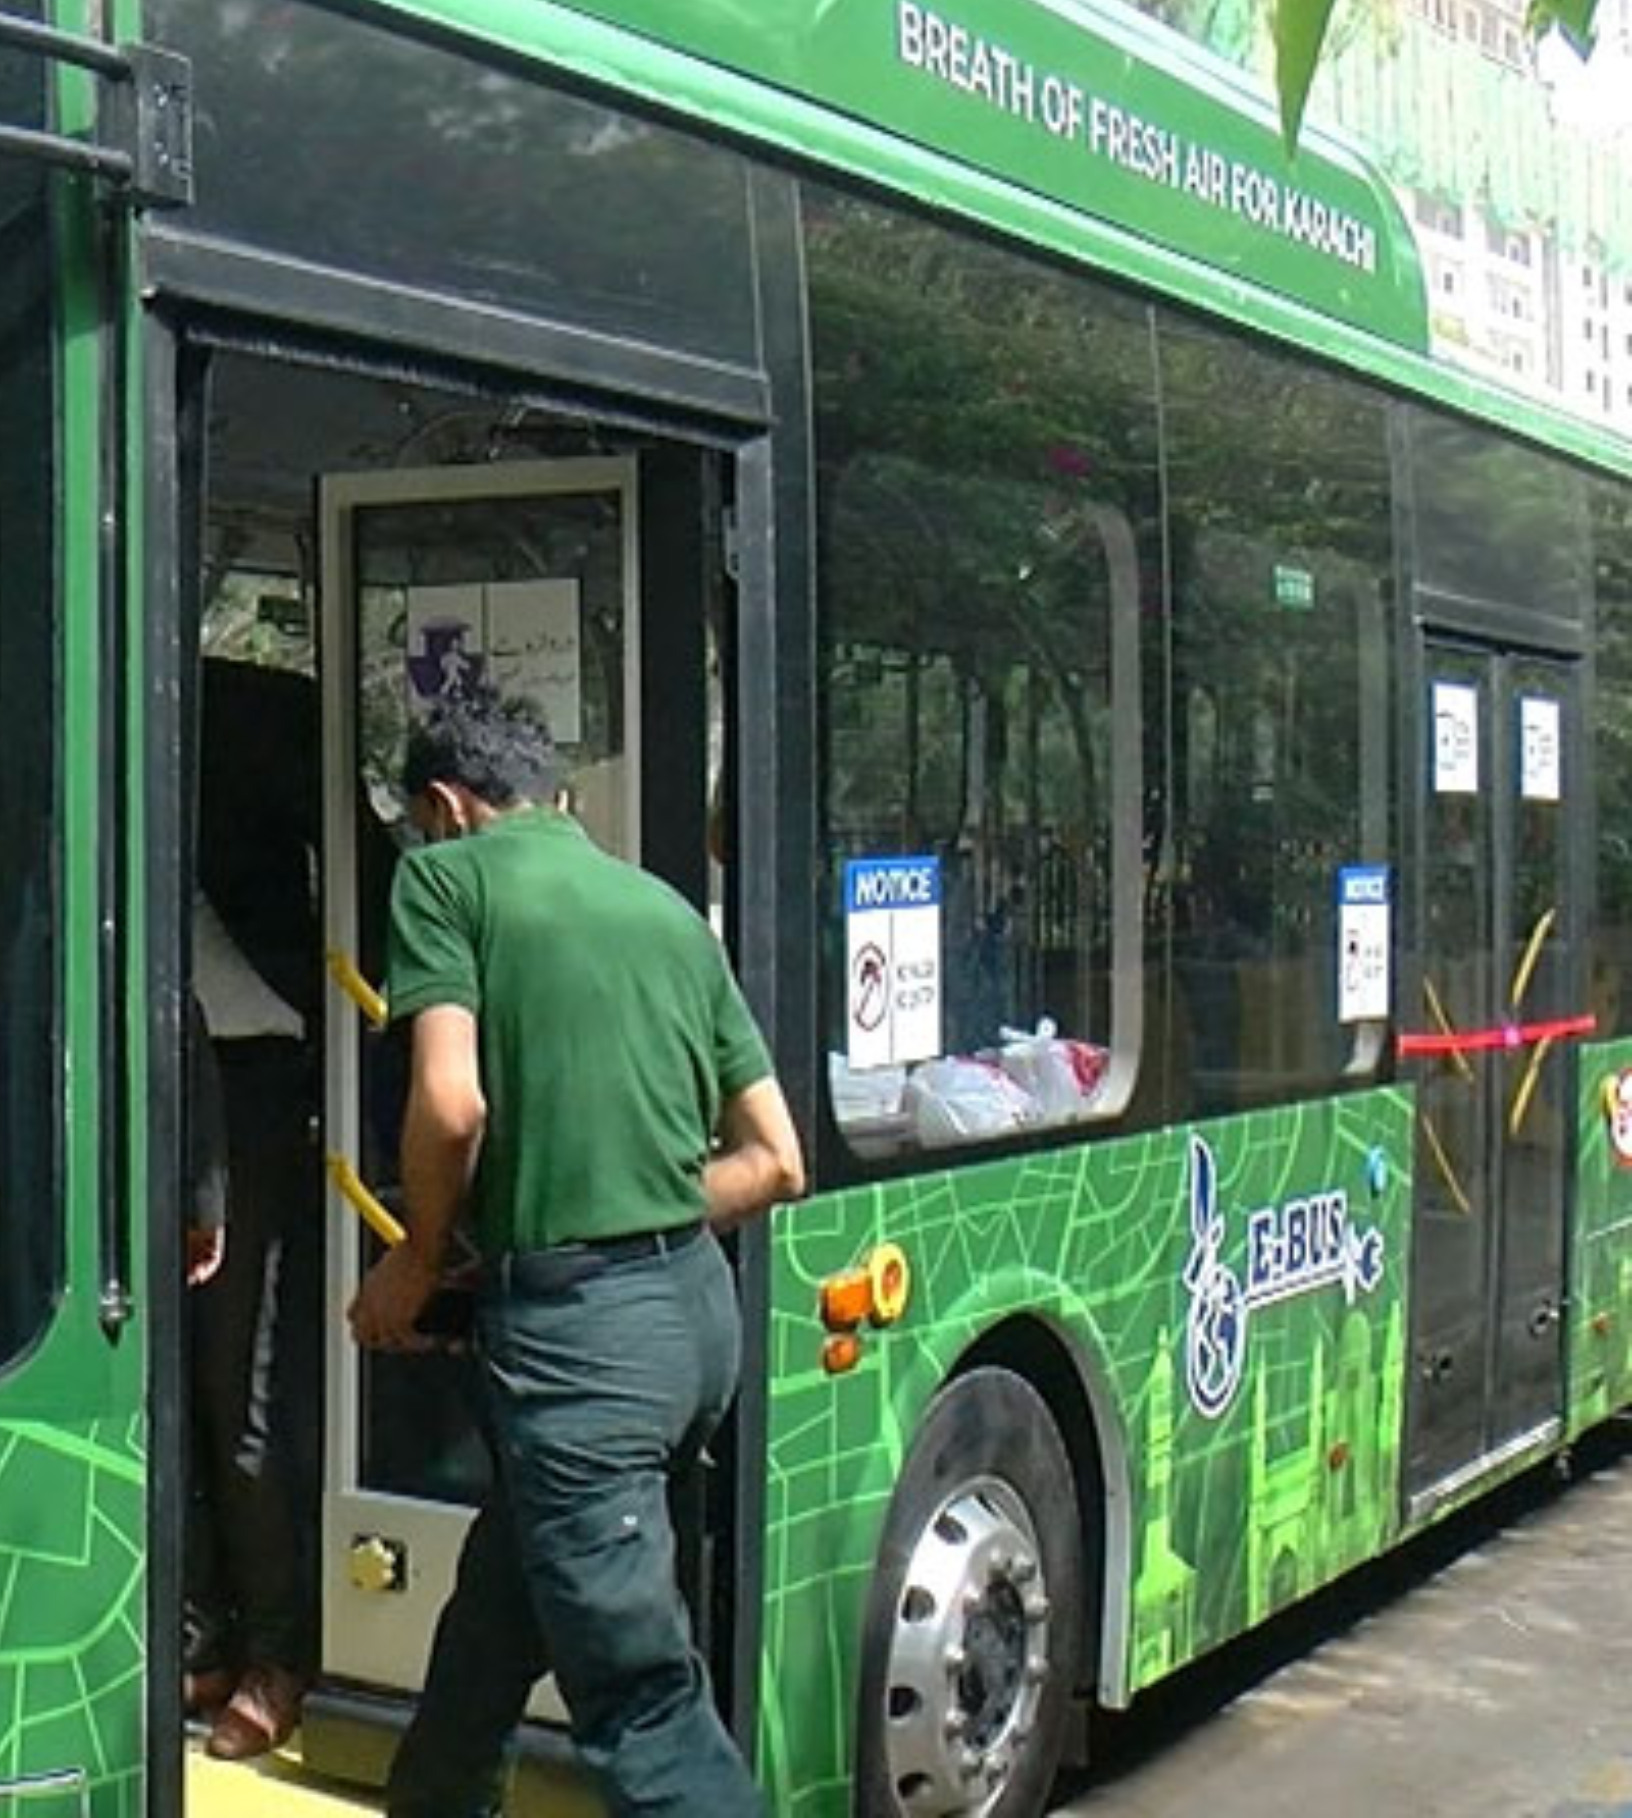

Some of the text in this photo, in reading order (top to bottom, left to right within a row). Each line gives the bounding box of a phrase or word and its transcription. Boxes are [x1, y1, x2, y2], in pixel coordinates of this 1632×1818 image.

[898, 1, 1376, 274] BREATH OF FRESH AIR FOR KARACHI
[856, 867, 932, 905] NOTICE
